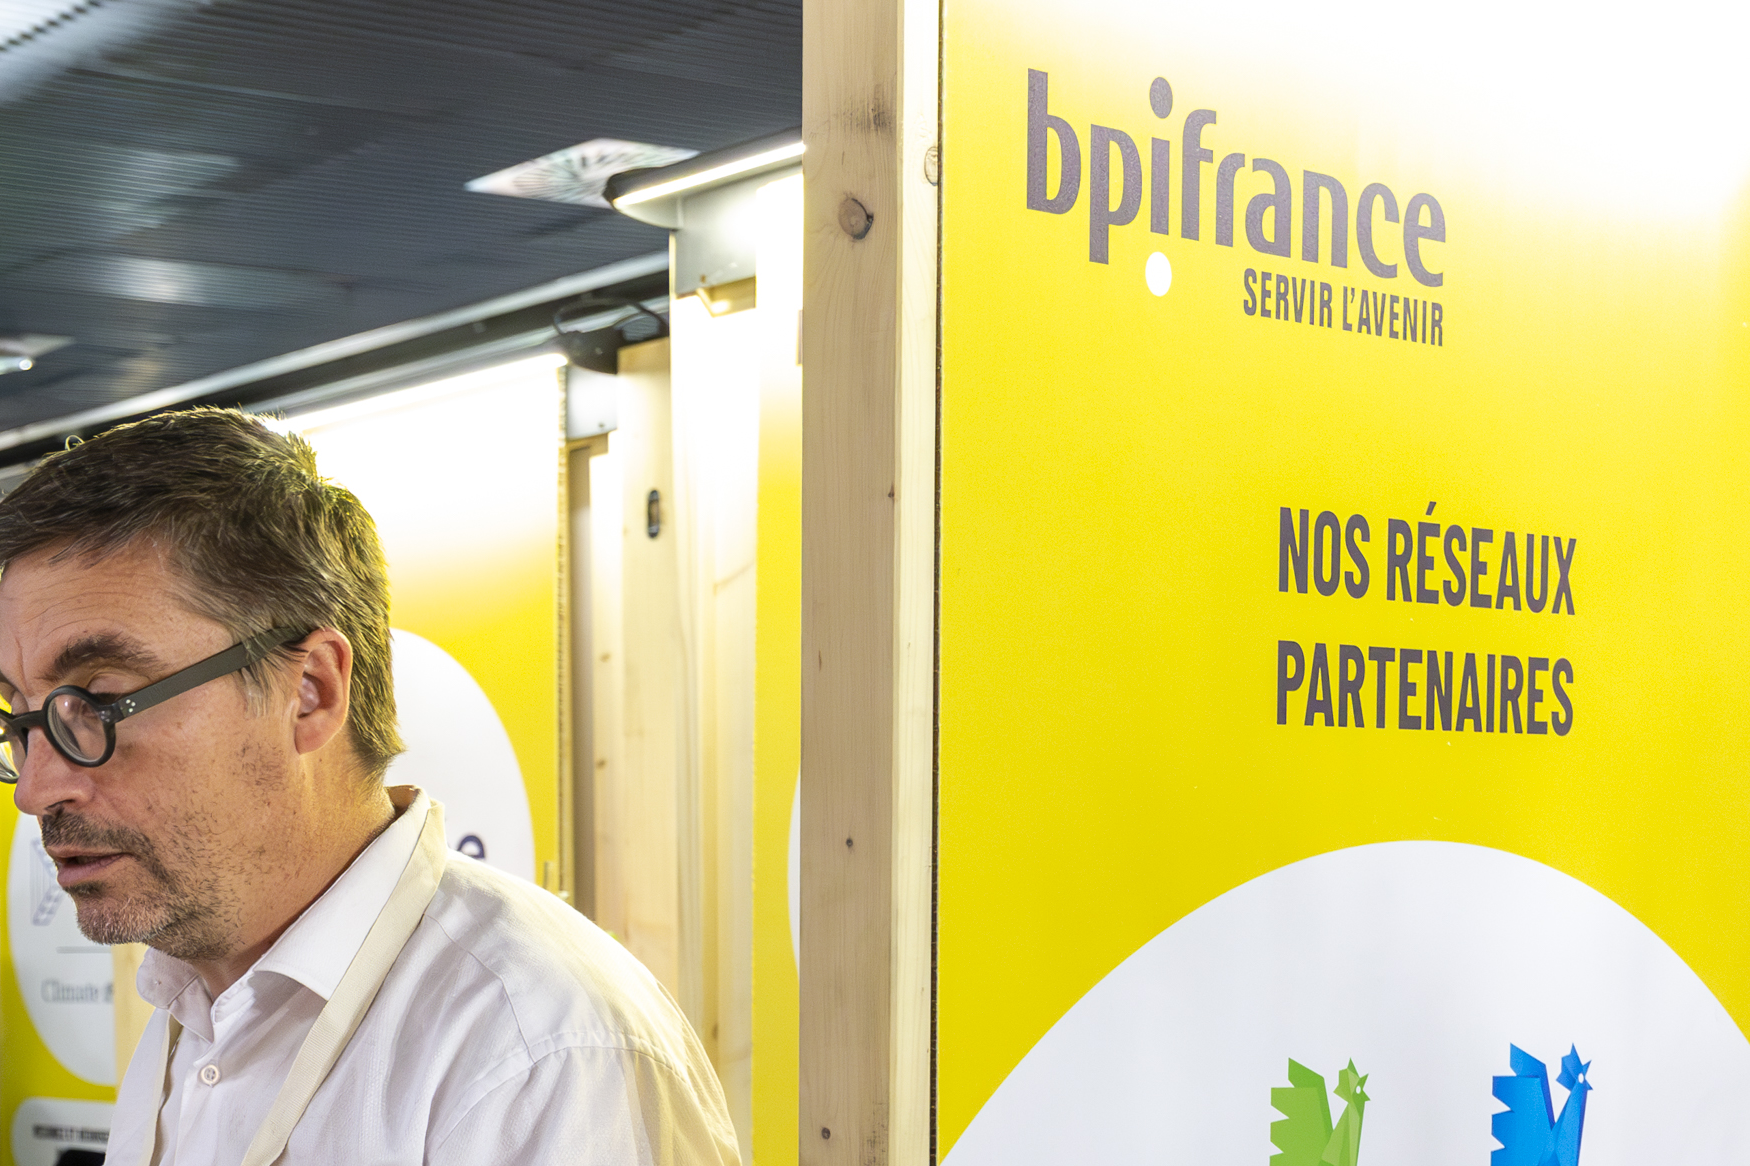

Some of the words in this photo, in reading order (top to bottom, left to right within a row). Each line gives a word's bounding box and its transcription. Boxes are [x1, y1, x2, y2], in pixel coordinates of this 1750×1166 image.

[1026, 68, 1446, 288] bpifrance
[1243, 268, 1333, 329] SERVIR
[1342, 285, 1444, 347] L'AVENIR
[1278, 507, 1370, 599] NOS
[1386, 501, 1576, 616] RÉSEAUX
[1277, 639, 1574, 737] PARTENAIRES
